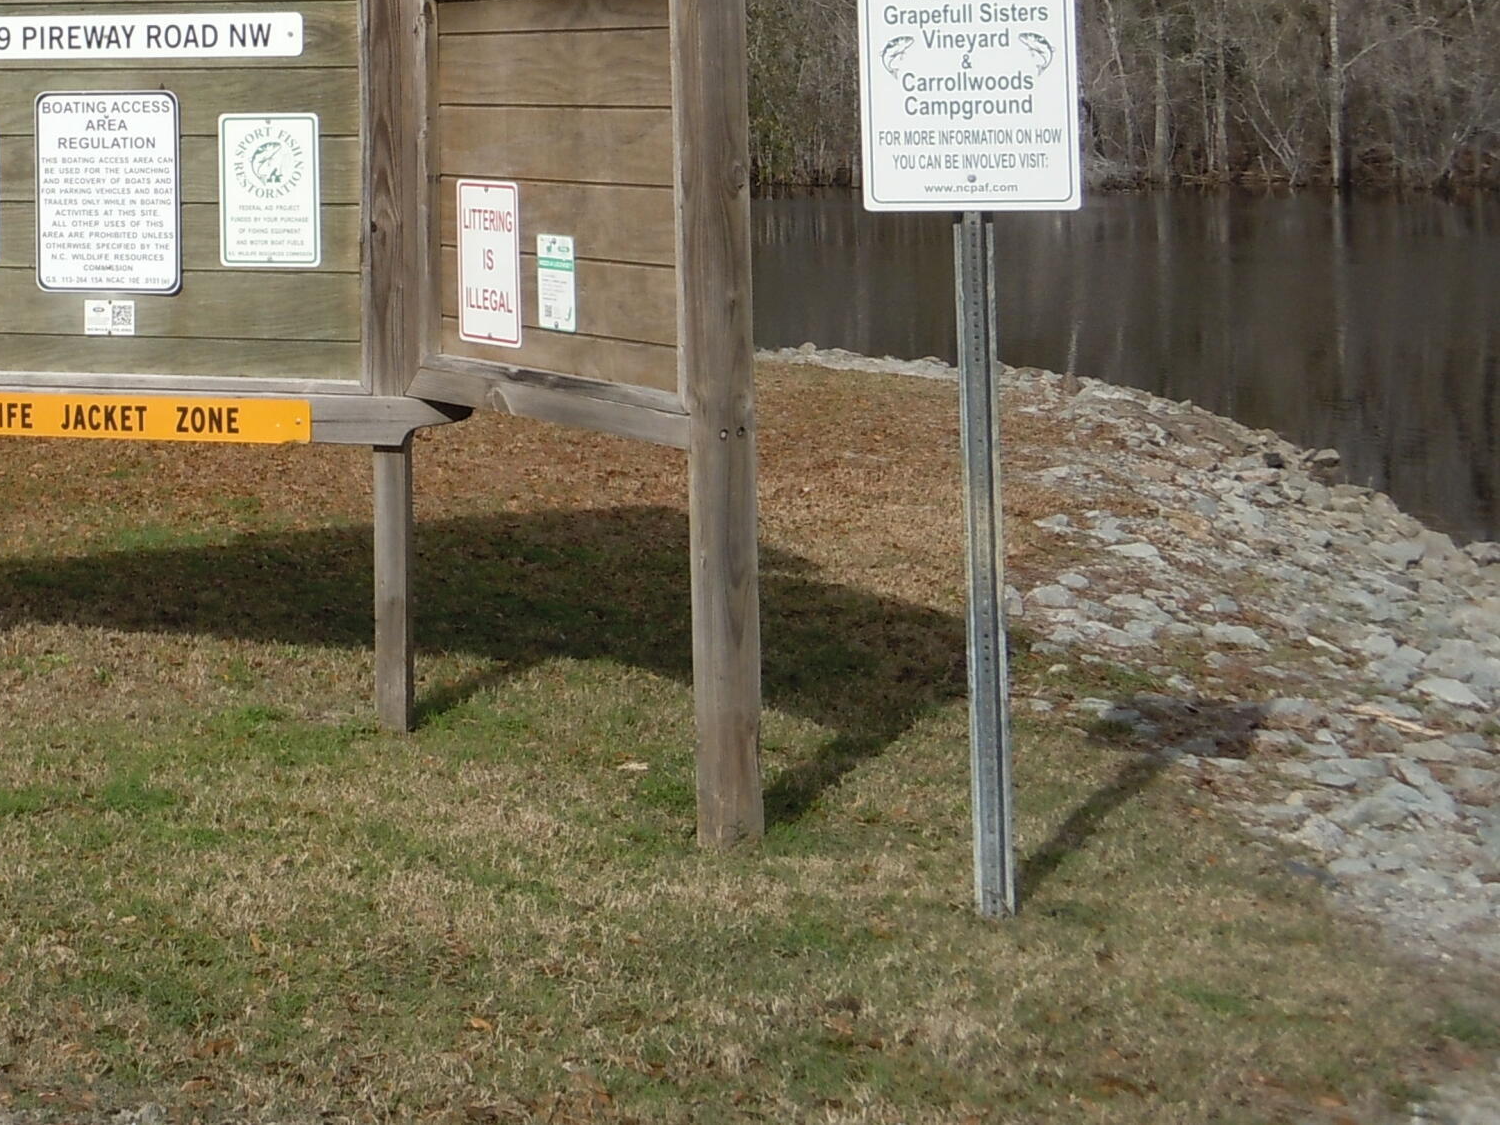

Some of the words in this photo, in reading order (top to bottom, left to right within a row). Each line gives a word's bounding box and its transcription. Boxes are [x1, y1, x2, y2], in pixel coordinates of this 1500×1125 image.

[884, 4, 972, 28] Grapefull
[980, 3, 1048, 23] Sisters
[23, 25, 135, 50] PIREWAY
[147, 25, 218, 49] ROAD
[230, 24, 272, 47] NW
[922, 28, 1009, 53] Vineyard
[961, 54, 972, 69] &
[902, 71, 1034, 92] Carrollwoods
[42, 101, 106, 114] BOATING
[111, 101, 170, 113] ACCESS
[905, 94, 1033, 120] Campground
[85, 119, 128, 131] AREA
[58, 137, 155, 149] REGULATION
[236, 127, 272, 156] SPORT
[278, 129, 302, 156] FISH
[879, 131, 900, 145] FOR
[904, 130, 935, 145] MORE
[939, 129, 1012, 145] INFORMATION
[1016, 129, 1032, 143] ON
[1036, 128, 1062, 143] HOW
[893, 155, 915, 169] YOU
[918, 154, 941, 169] CAN
[945, 154, 959, 169] BE
[962, 153, 1016, 169] INVOLVED
[1019, 153, 1048, 168] VISIT:
[924, 183, 1018, 194] www.ncpaf.com
[464, 208, 512, 232] LITTERING
[483, 249, 494, 270] IS
[466, 287, 513, 313] ILLEGAL
[61, 405, 148, 431] JACKET
[176, 406, 239, 433] ZONE
